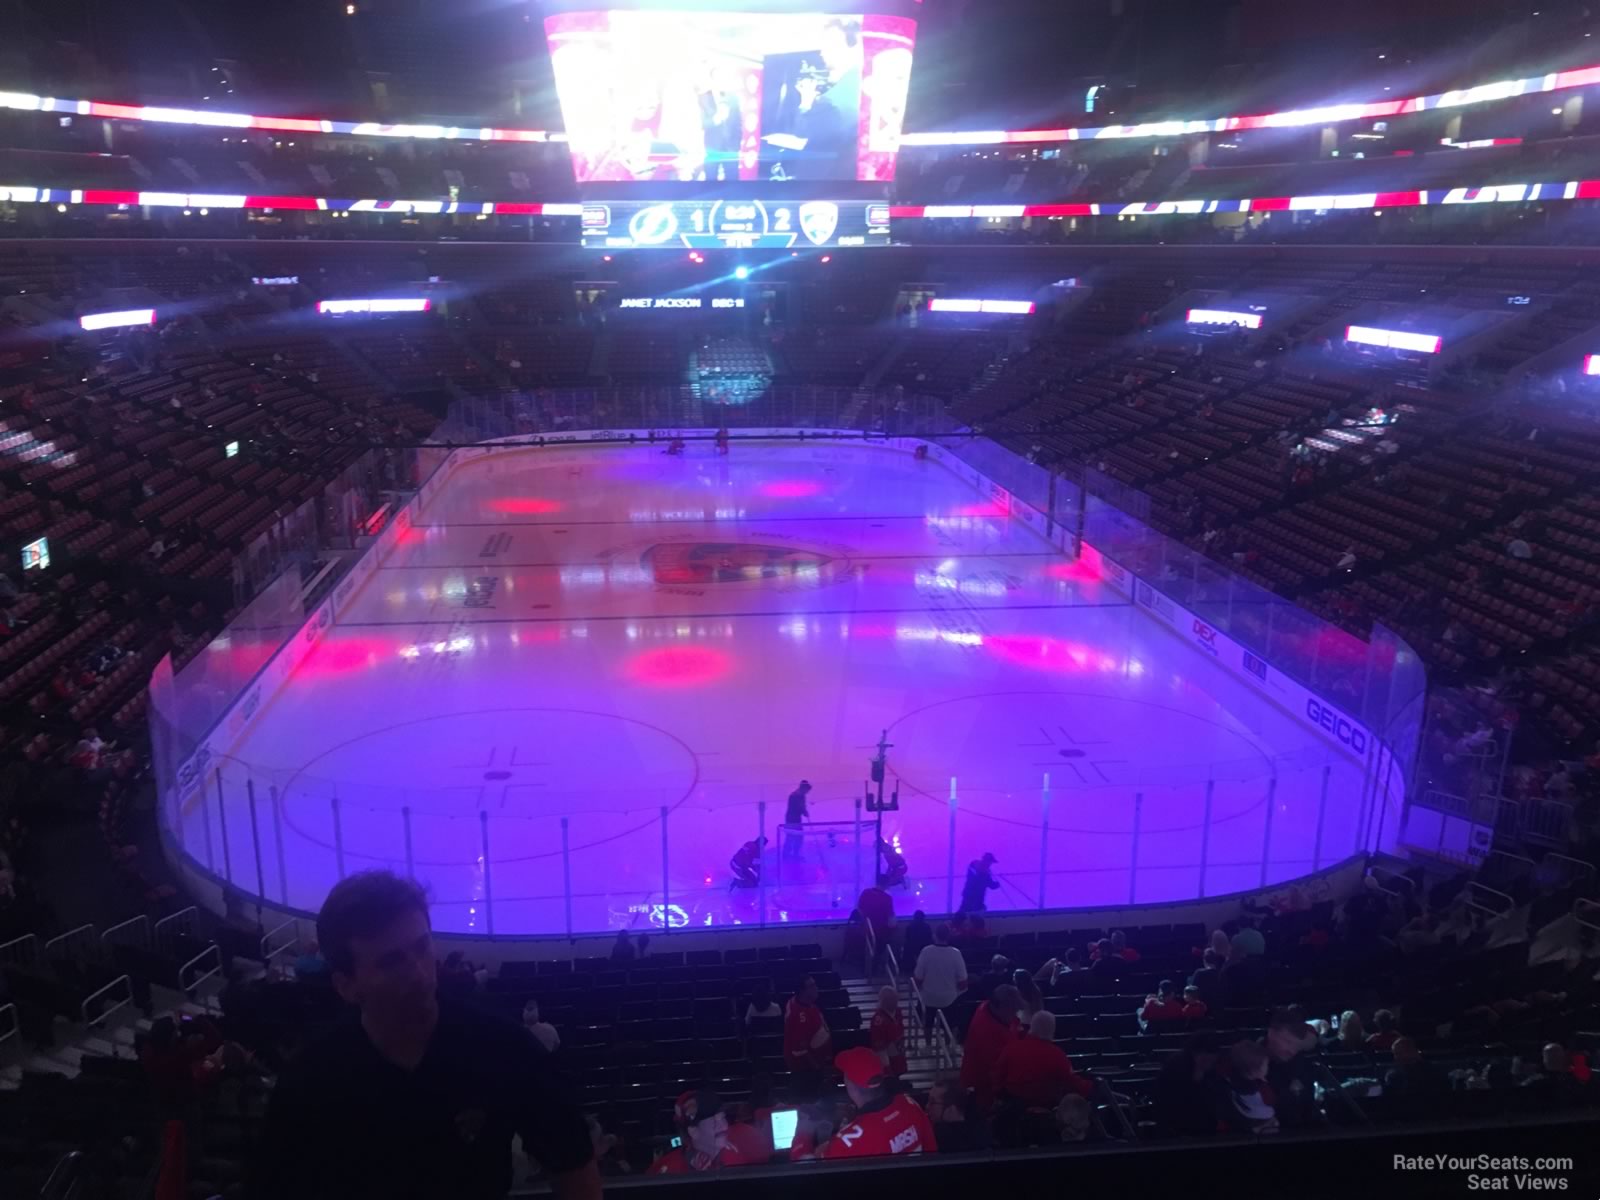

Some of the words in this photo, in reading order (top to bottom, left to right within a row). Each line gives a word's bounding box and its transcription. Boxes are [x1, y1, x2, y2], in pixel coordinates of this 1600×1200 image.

[690, 208, 704, 231] 1
[774, 207, 791, 231] 2
[619, 298, 653, 308] JANET
[653, 298, 701, 308] JACKSON
[711, 298, 734, 308] DEC
[1192, 618, 1217, 646] DEX
[1307, 697, 1366, 755] GEICO
